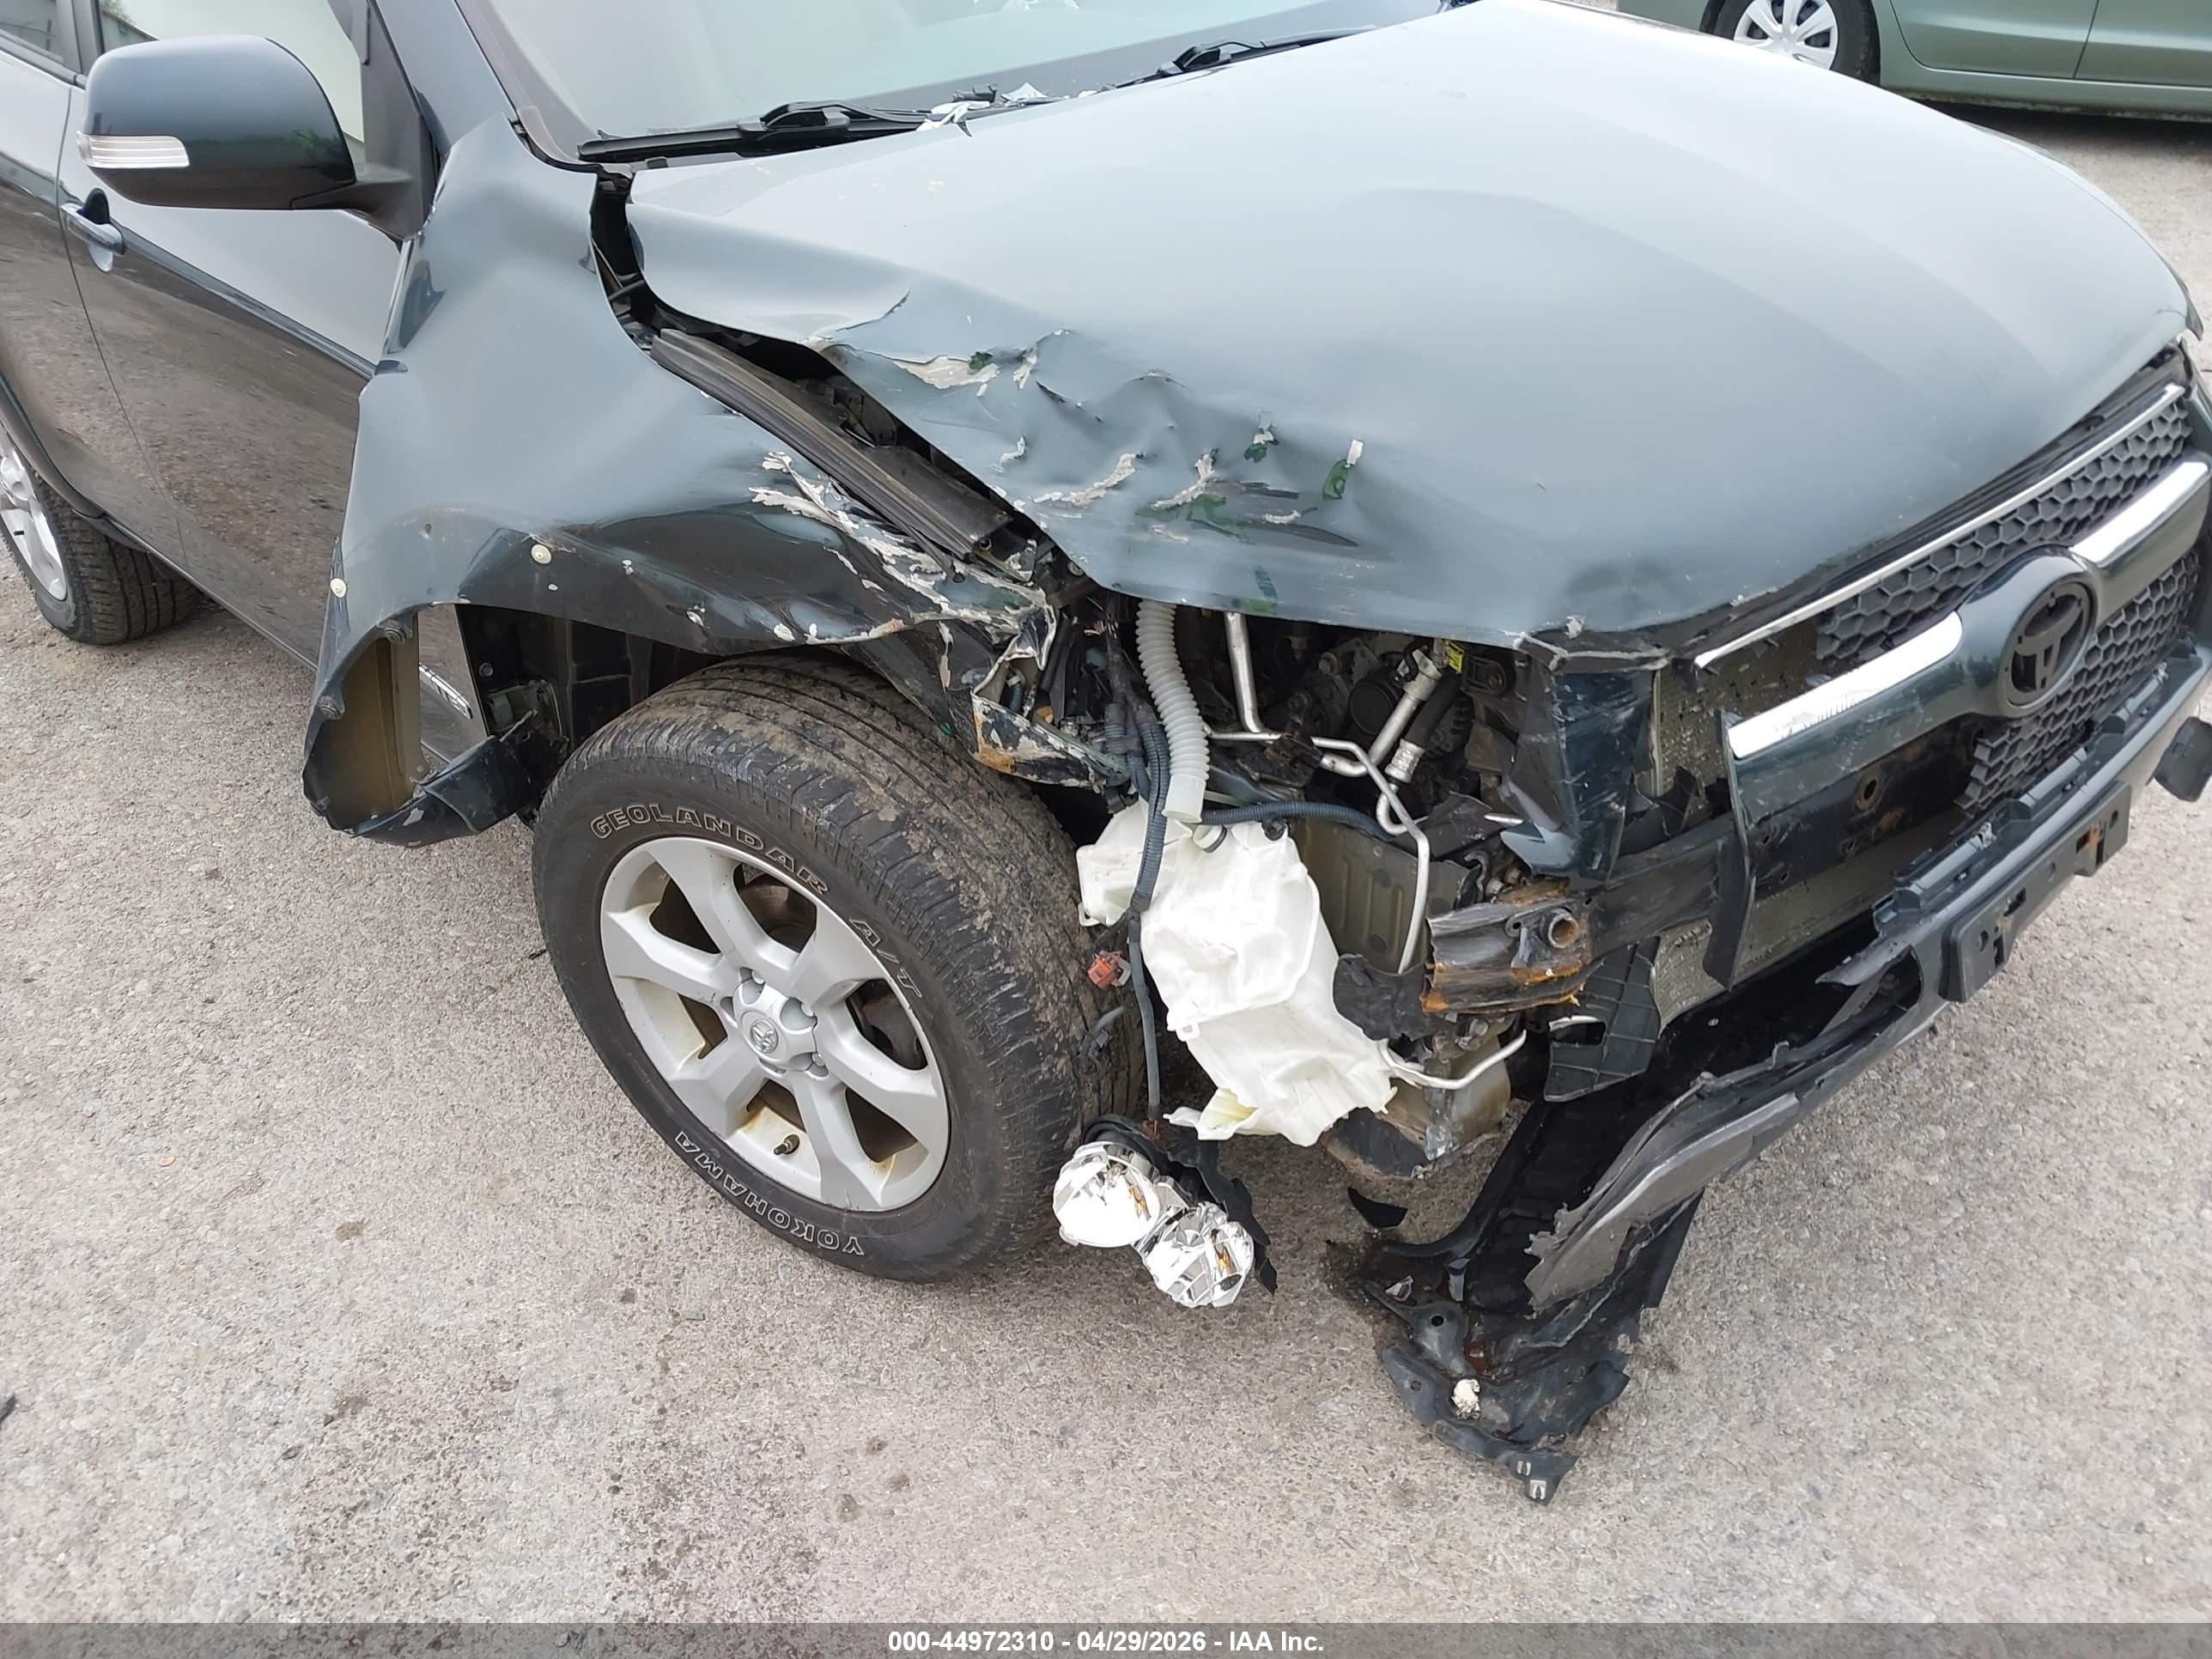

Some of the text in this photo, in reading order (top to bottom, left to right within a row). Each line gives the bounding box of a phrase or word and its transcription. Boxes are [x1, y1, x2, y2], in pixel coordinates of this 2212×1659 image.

[590, 803, 922, 1000] GEOLANDAR A/T
[674, 1131, 866, 1256] YOKOHAMA
